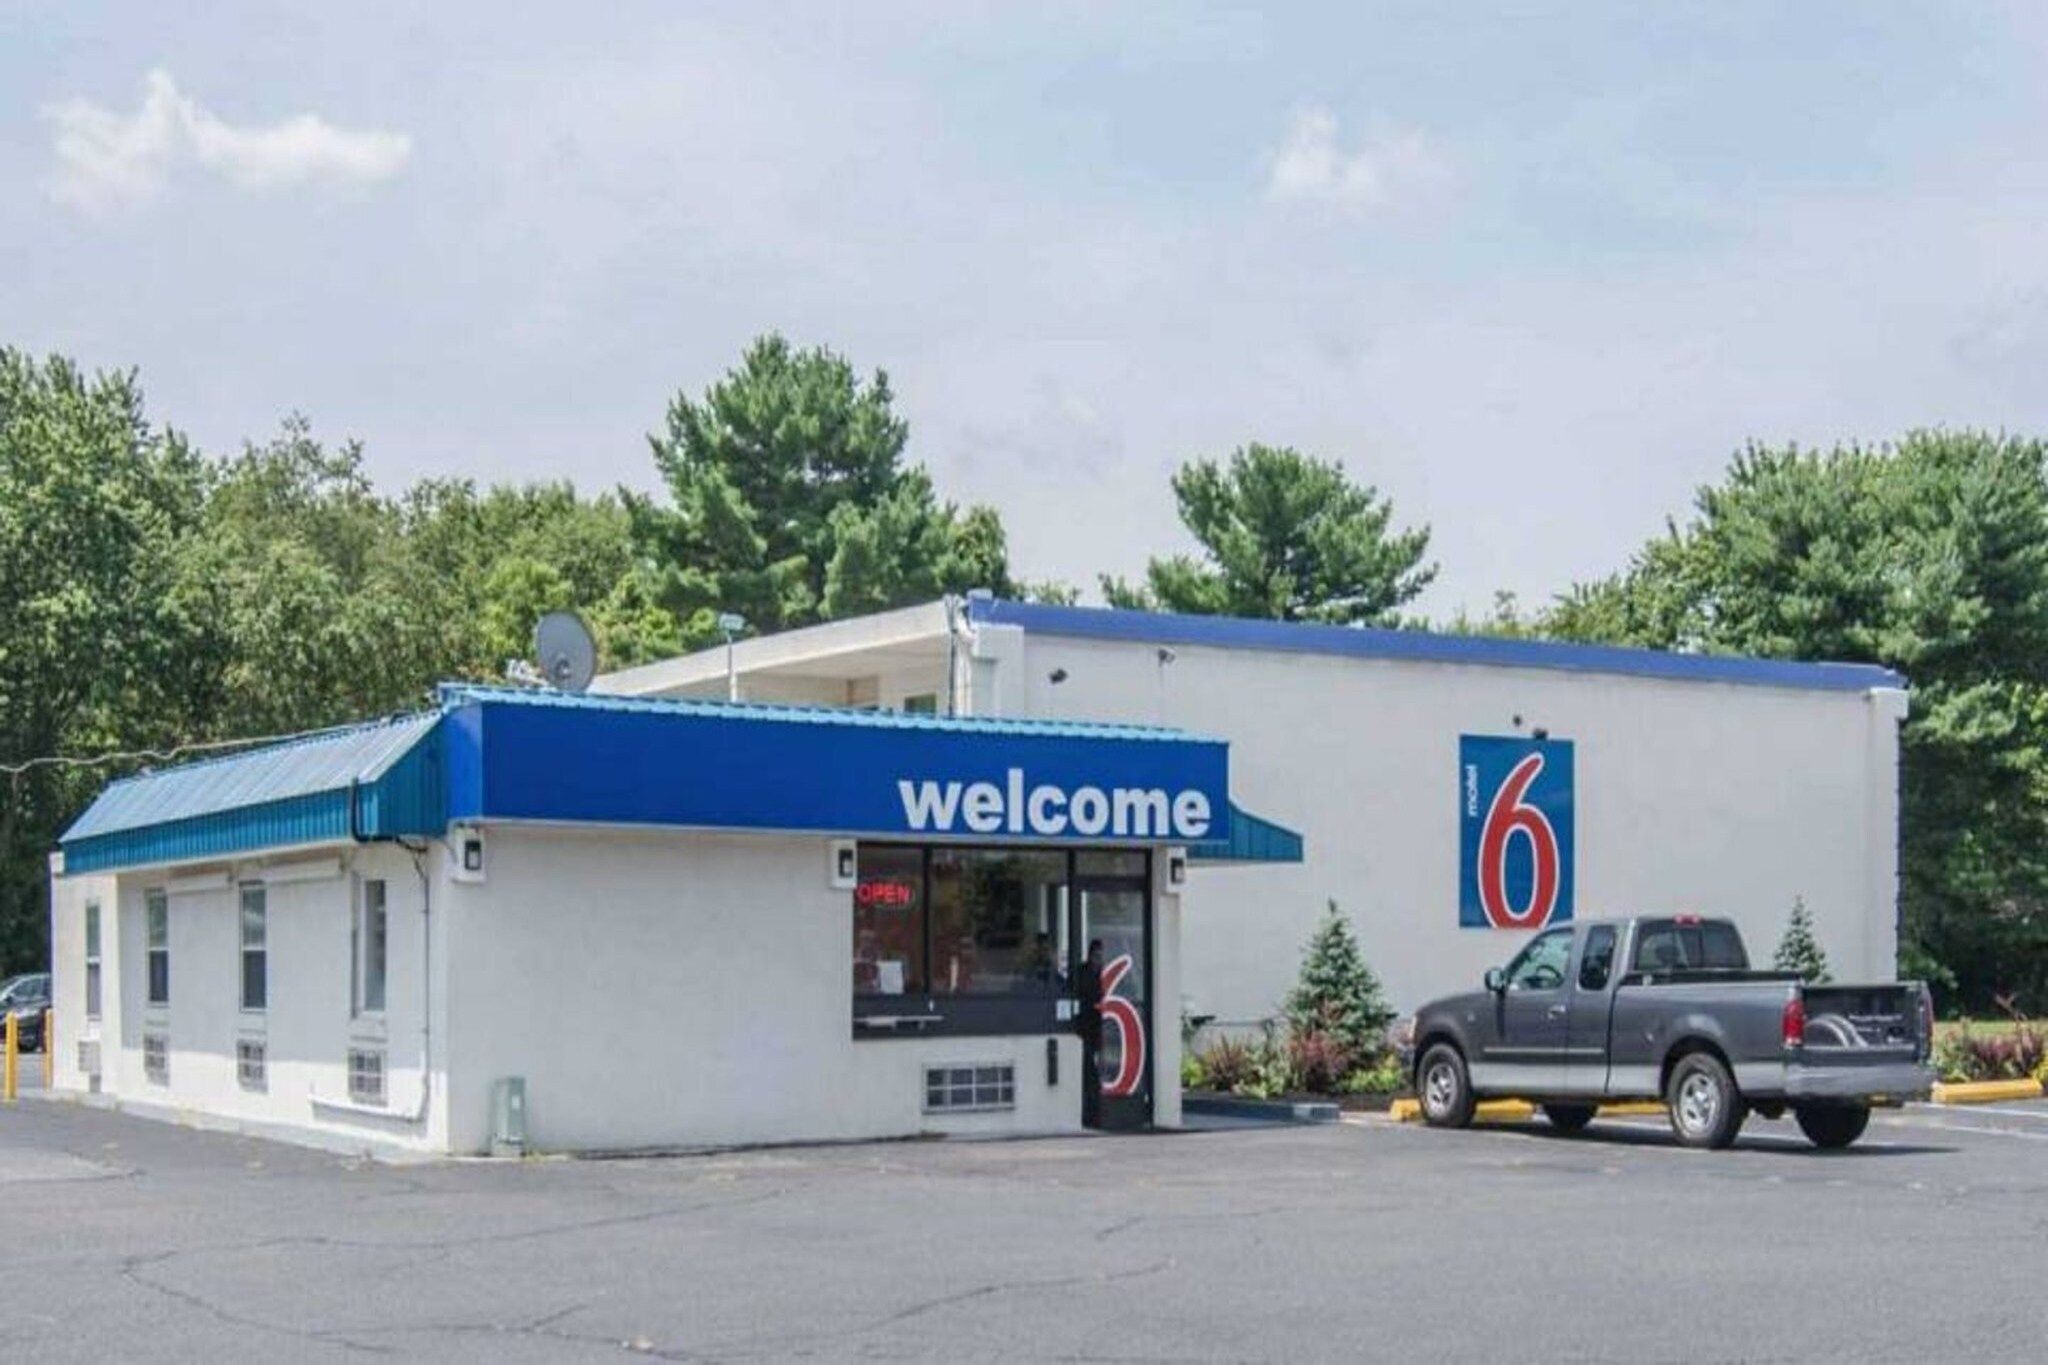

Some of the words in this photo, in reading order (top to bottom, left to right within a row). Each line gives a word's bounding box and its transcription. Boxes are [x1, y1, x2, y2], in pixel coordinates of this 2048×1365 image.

[898, 767, 1211, 837] welcome
[1478, 752, 1560, 929] 6
[856, 883, 910, 904] OPEN
